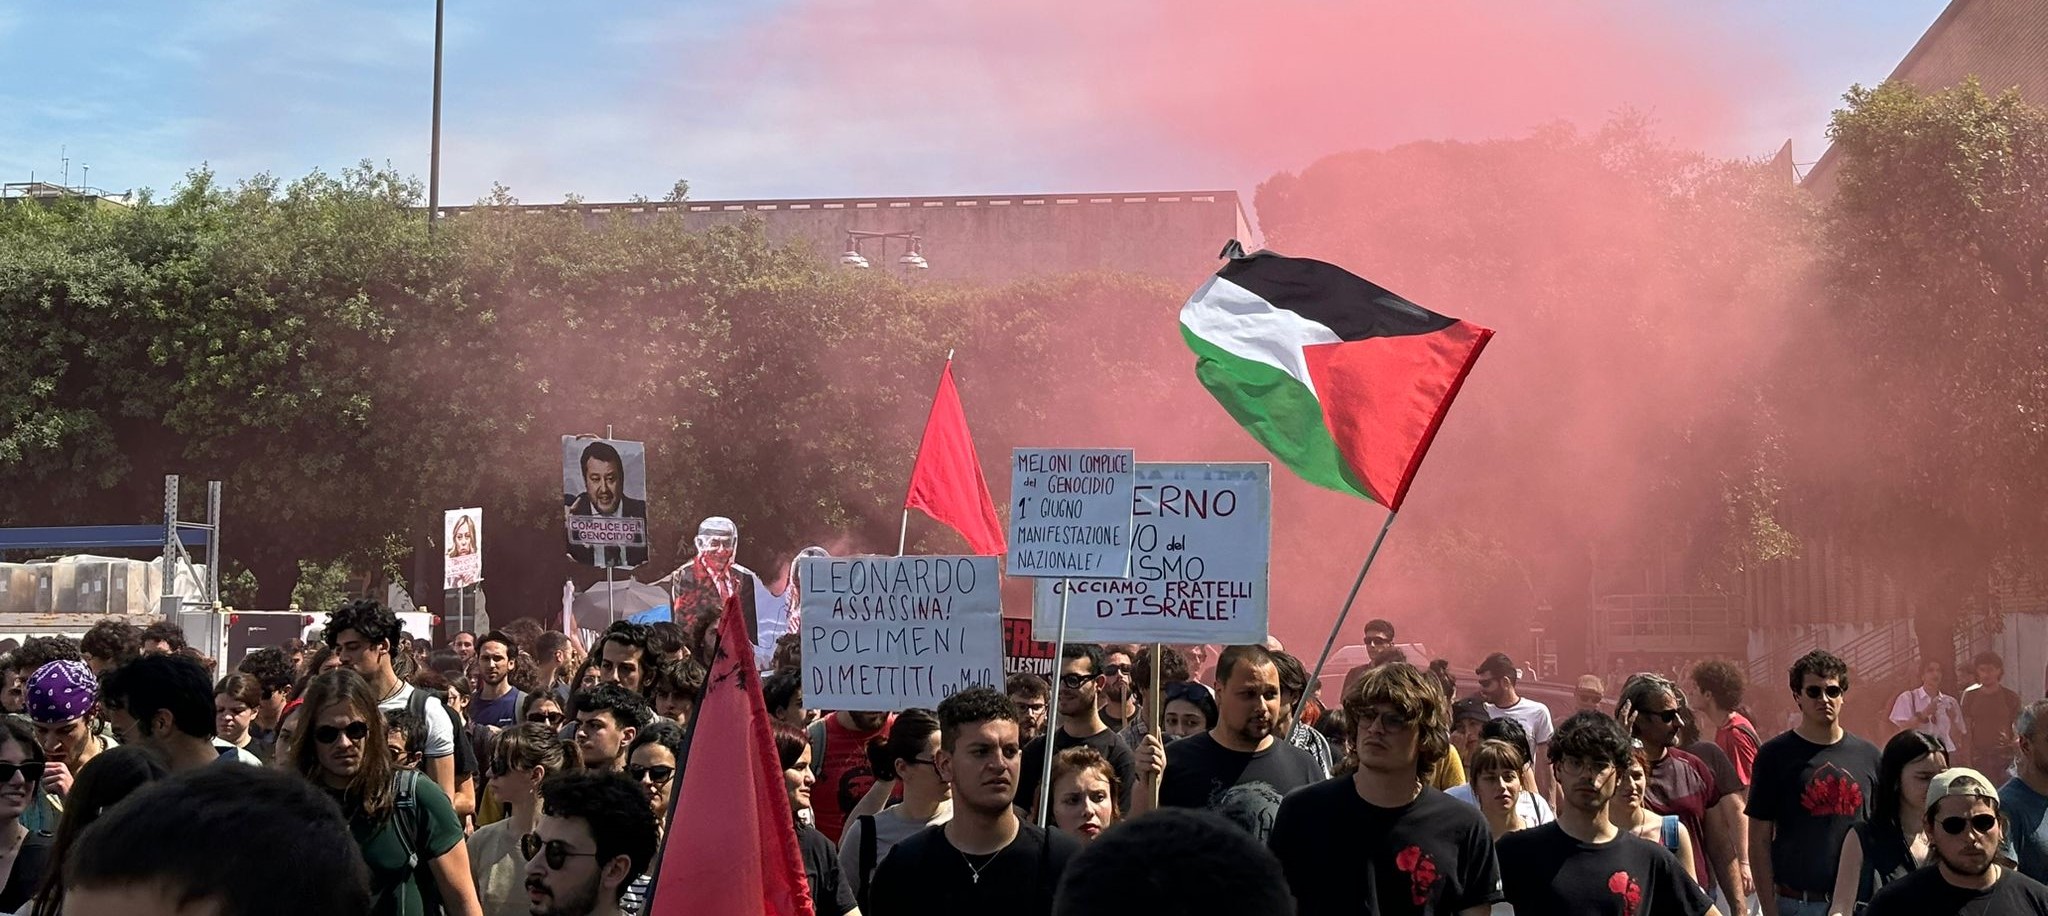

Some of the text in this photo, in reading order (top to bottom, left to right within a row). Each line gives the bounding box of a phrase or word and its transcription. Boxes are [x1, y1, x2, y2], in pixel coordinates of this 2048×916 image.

[1018, 454, 1128, 474] MELONI COMPLICE
[1023, 474, 1115, 496] del GENOCIDIO
[1040, 497, 1083, 519] GIUGNO
[1132, 485, 1237, 519] ERNO
[571, 521, 621, 532] COMPLICE
[579, 530, 633, 541] GENOCIDIO
[1017, 525, 1121, 547] MANIFESTAZIONE
[1166, 534, 1185, 551] del
[809, 558, 976, 595] LEONARDO
[1130, 554, 1205, 582] ISMO
[1053, 580, 1252, 599] CACCIAMO FRATELLI
[832, 595, 953, 622] ASSASSINA!
[1096, 595, 1237, 621] D'ISRAELE!
[812, 626, 966, 655] POLIMENI
[812, 665, 934, 697] DIMETTITI
